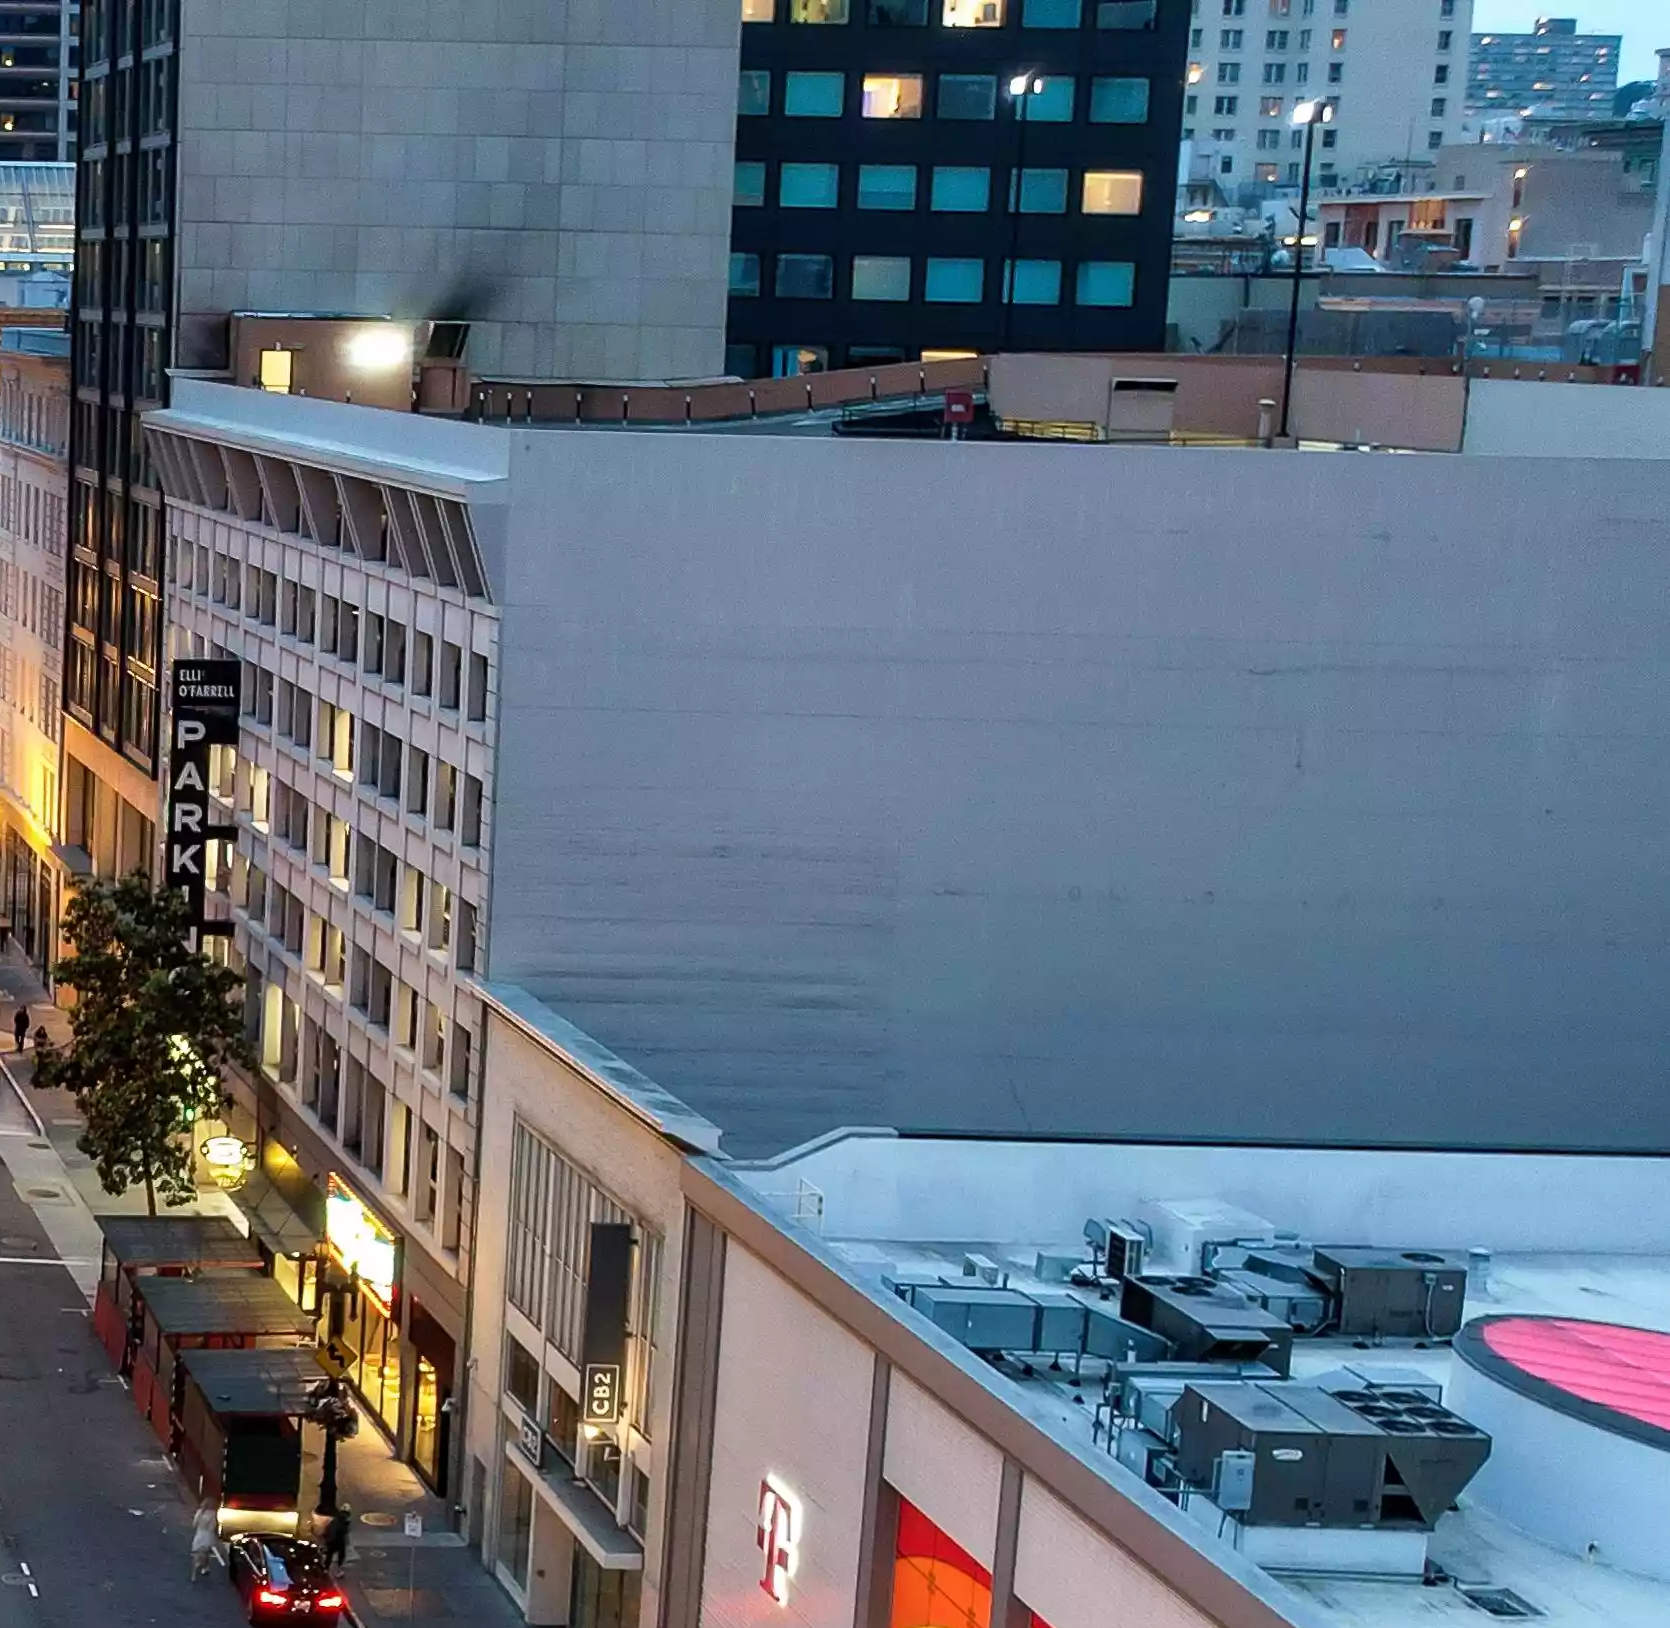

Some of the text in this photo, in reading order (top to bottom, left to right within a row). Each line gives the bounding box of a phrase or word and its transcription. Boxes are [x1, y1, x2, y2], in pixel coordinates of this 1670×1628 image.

[179, 669, 205, 681] ELLI
[178, 684, 235, 698] O'FARRELL
[172, 719, 206, 954] PARKI
[592, 1373, 611, 1415] CB2
